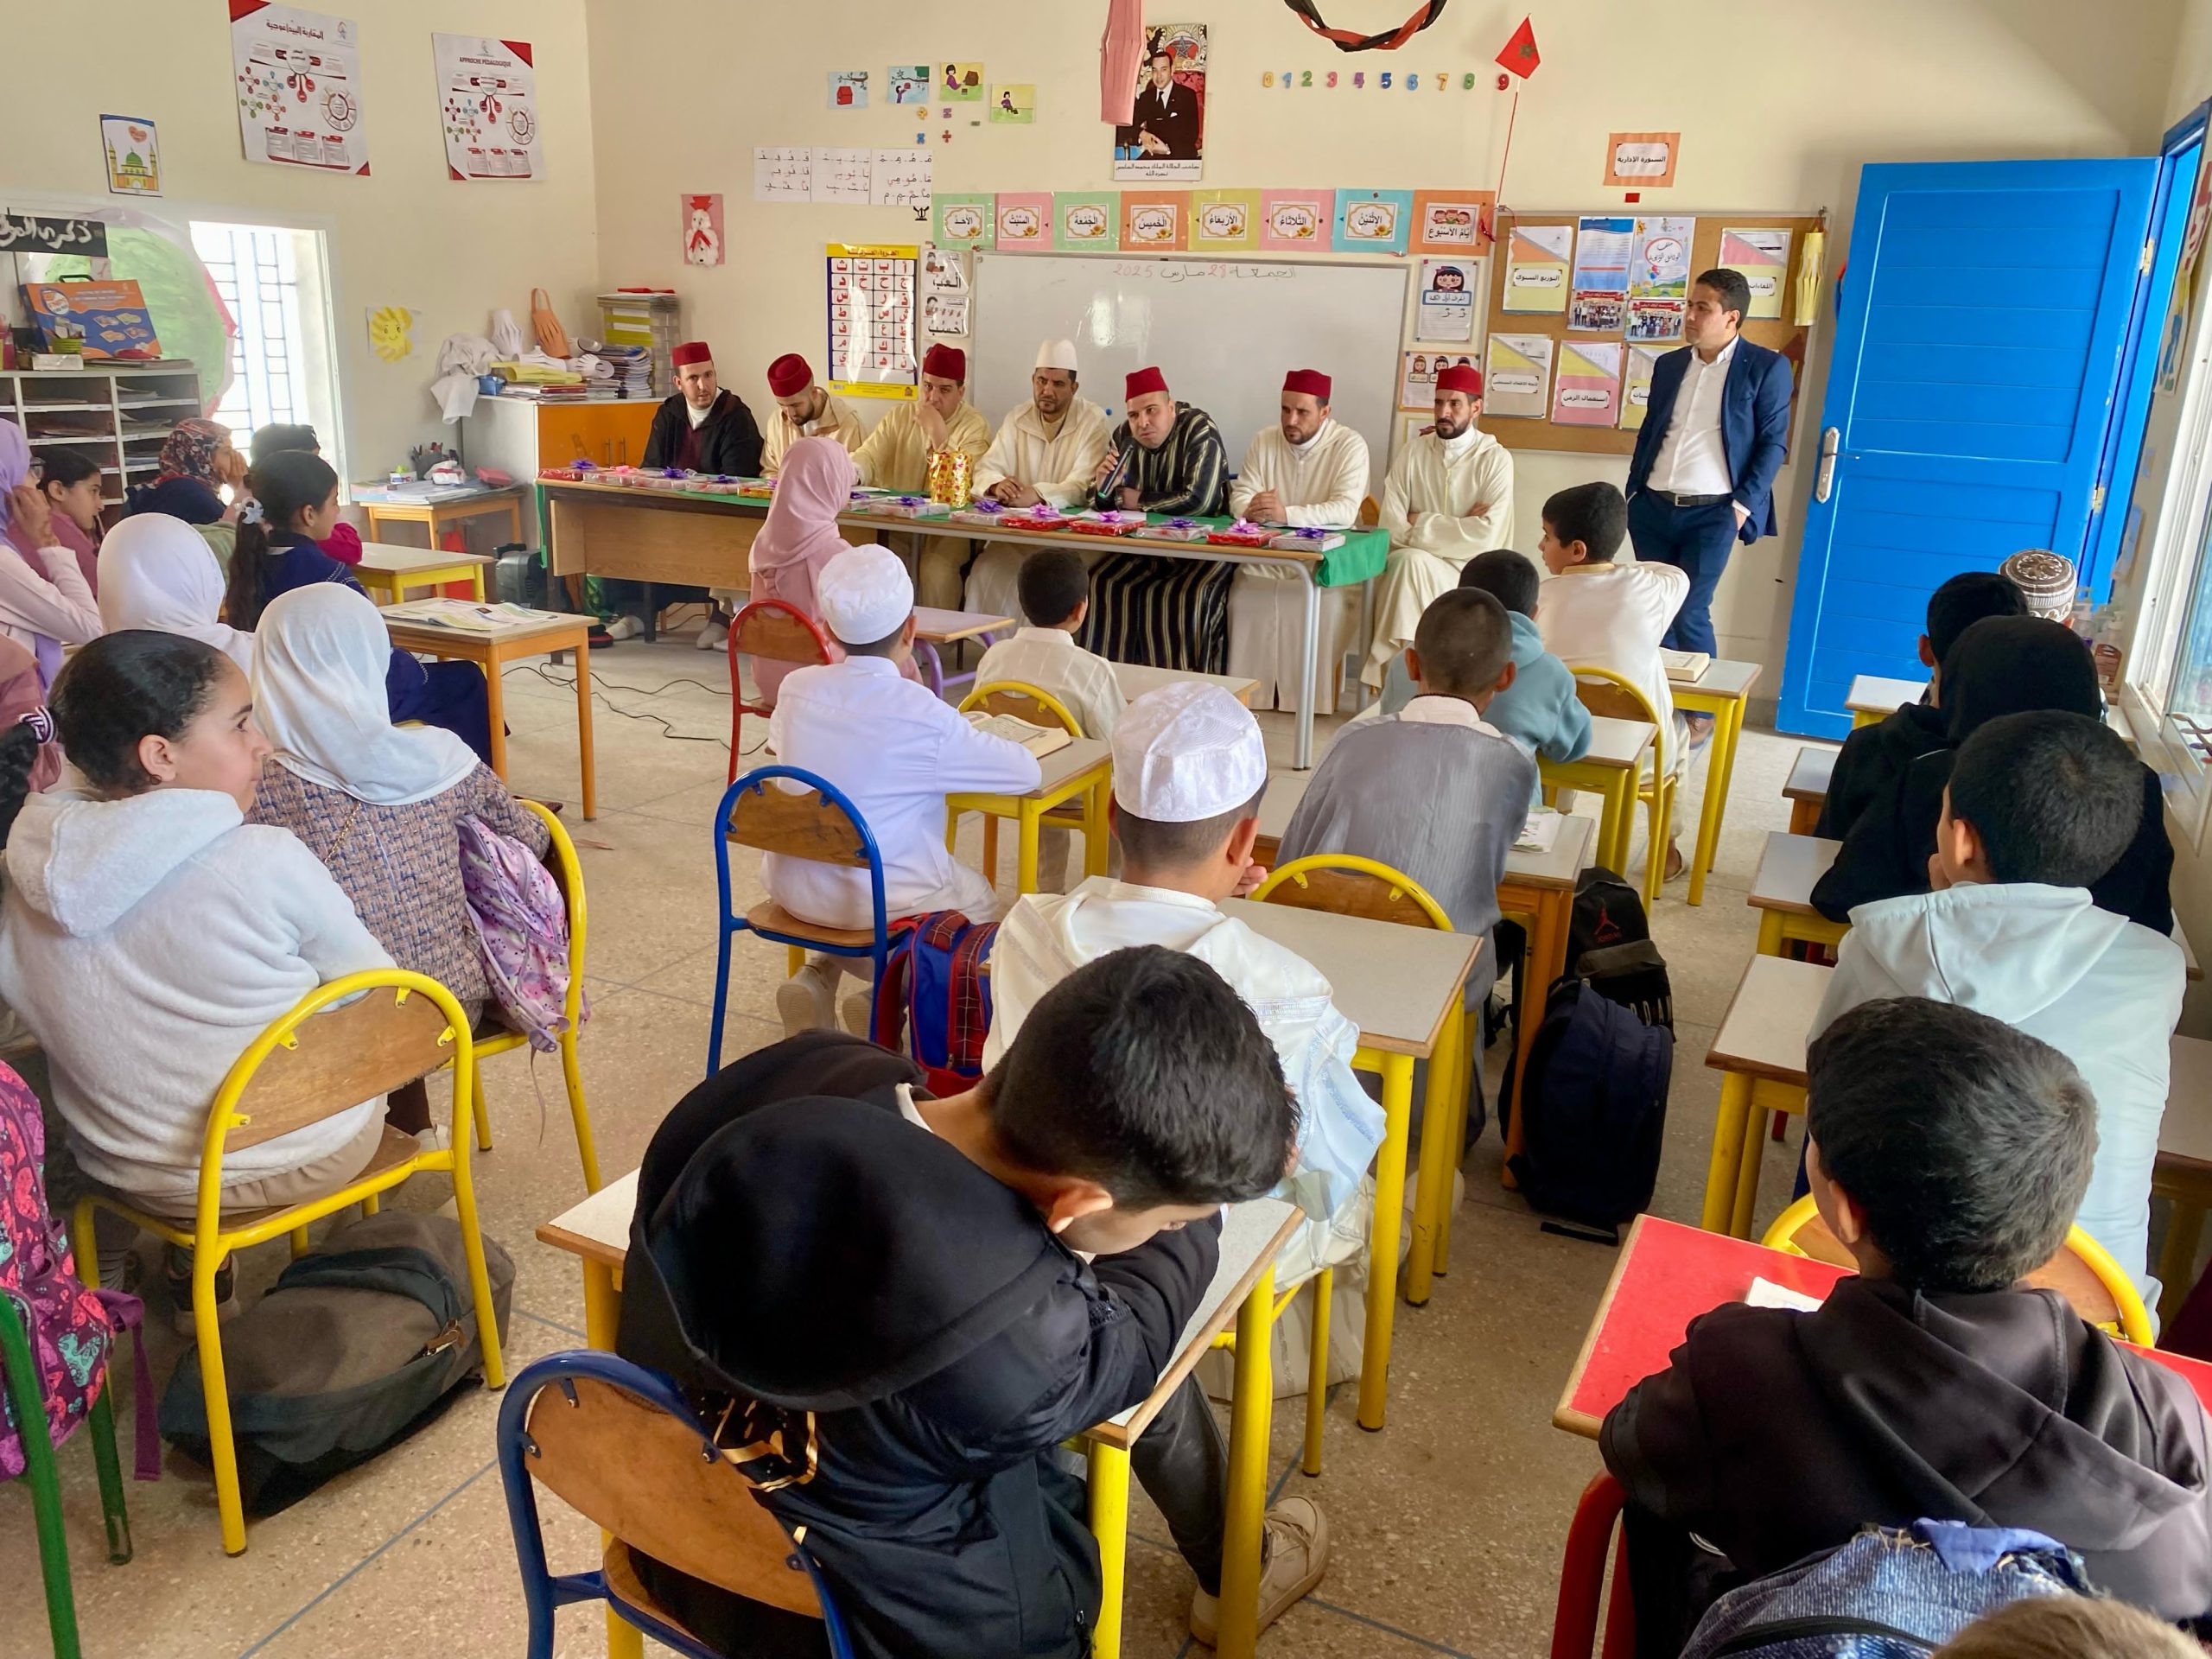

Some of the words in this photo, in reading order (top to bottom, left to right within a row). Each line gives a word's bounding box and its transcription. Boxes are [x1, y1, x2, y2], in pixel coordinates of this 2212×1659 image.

[1263, 72, 1274, 87] 0
[1282, 73, 1292, 88] 1
[1302, 71, 1313, 86] 2
[1327, 72, 1338, 87] 3
[1354, 72, 1364, 88] 4
[1382, 73, 1392, 89] 5
[1408, 74, 1418, 91] 6
[1437, 73, 1449, 91] 7
[1464, 73, 1475, 90] 8
[1497, 73, 1510, 91] 9
[1113, 264, 1154, 277] 2025
